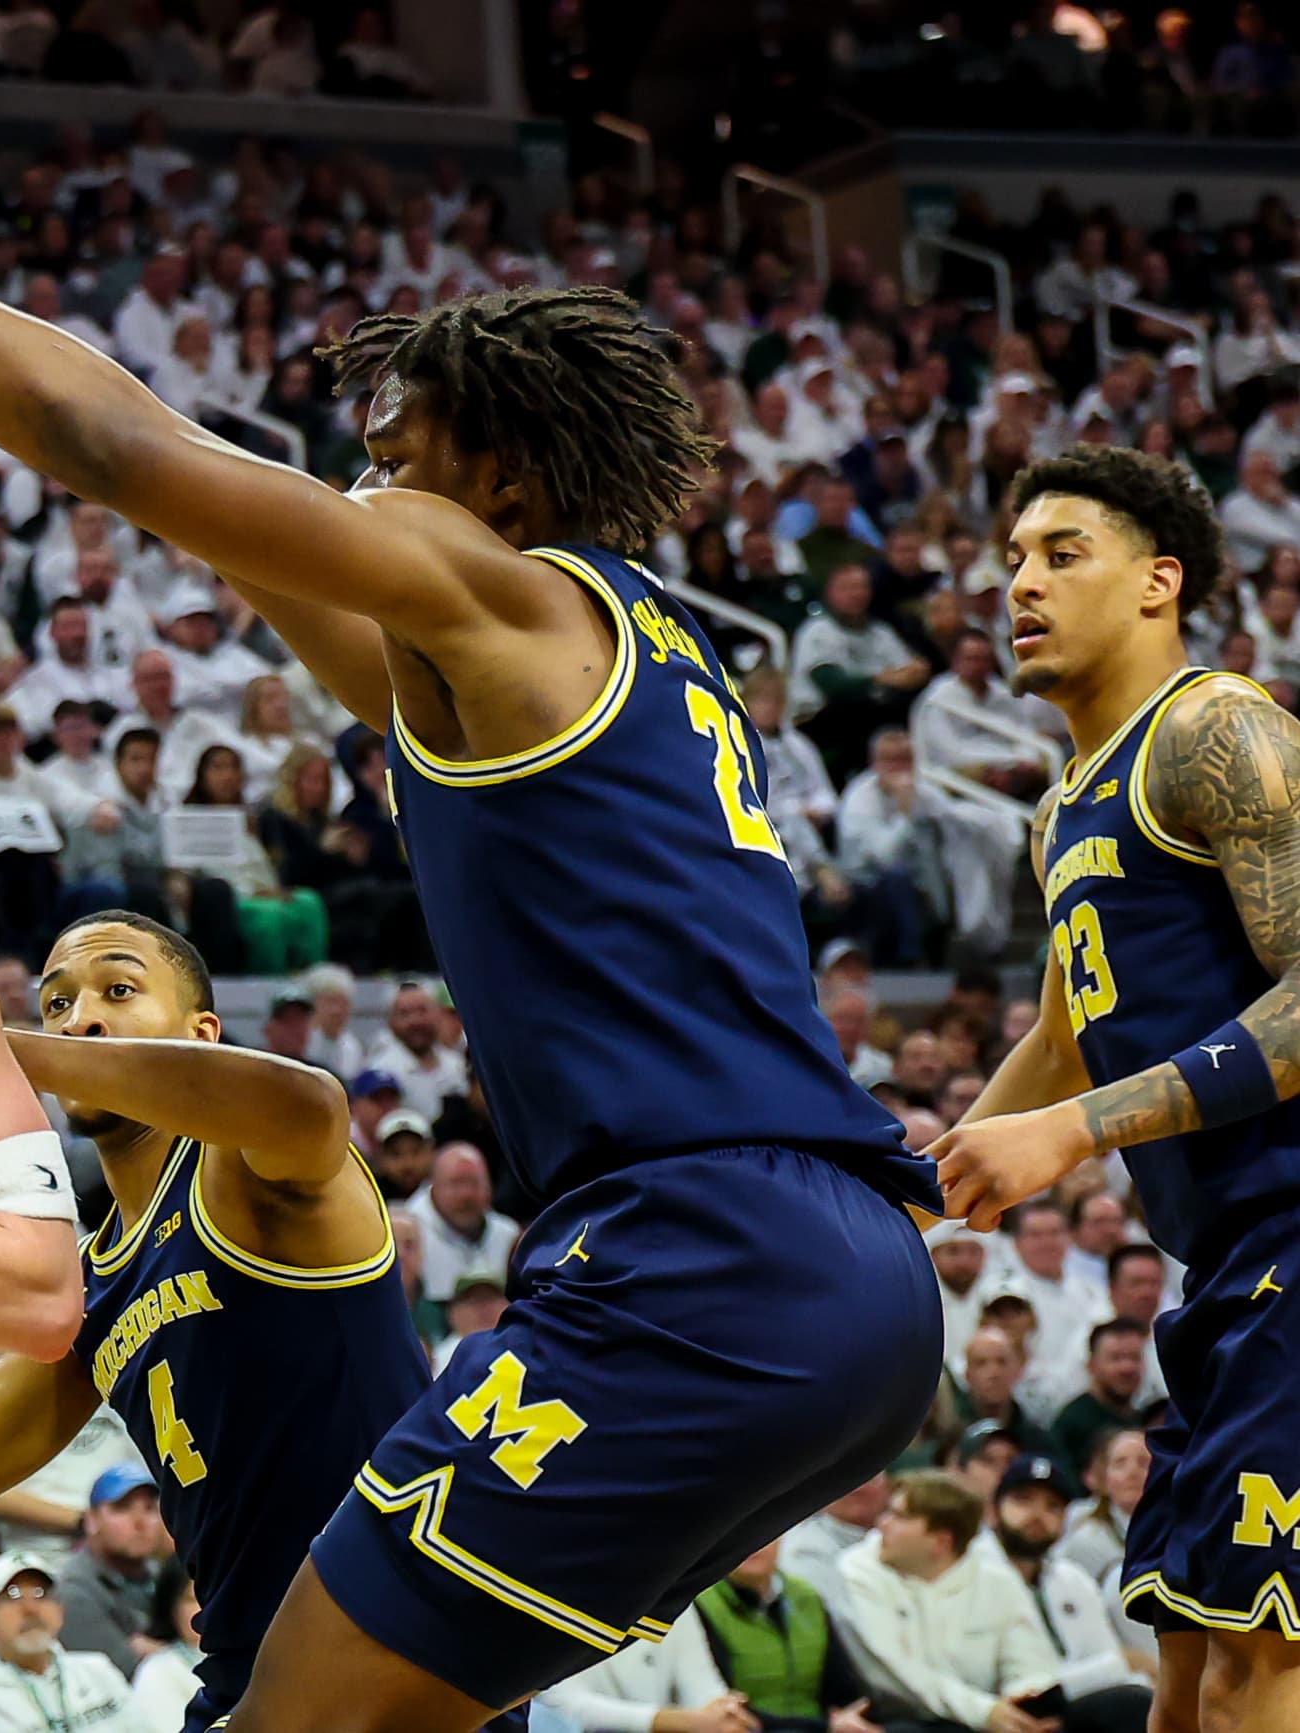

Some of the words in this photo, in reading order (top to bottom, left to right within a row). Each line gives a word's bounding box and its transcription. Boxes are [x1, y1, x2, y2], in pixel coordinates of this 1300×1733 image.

[1053, 900, 1118, 1040] 23
[92, 1270, 224, 1403] MICHIGAN
[148, 1358, 208, 1488] 4
[445, 1350, 588, 1490] M
[1232, 1471, 1300, 1550] M
